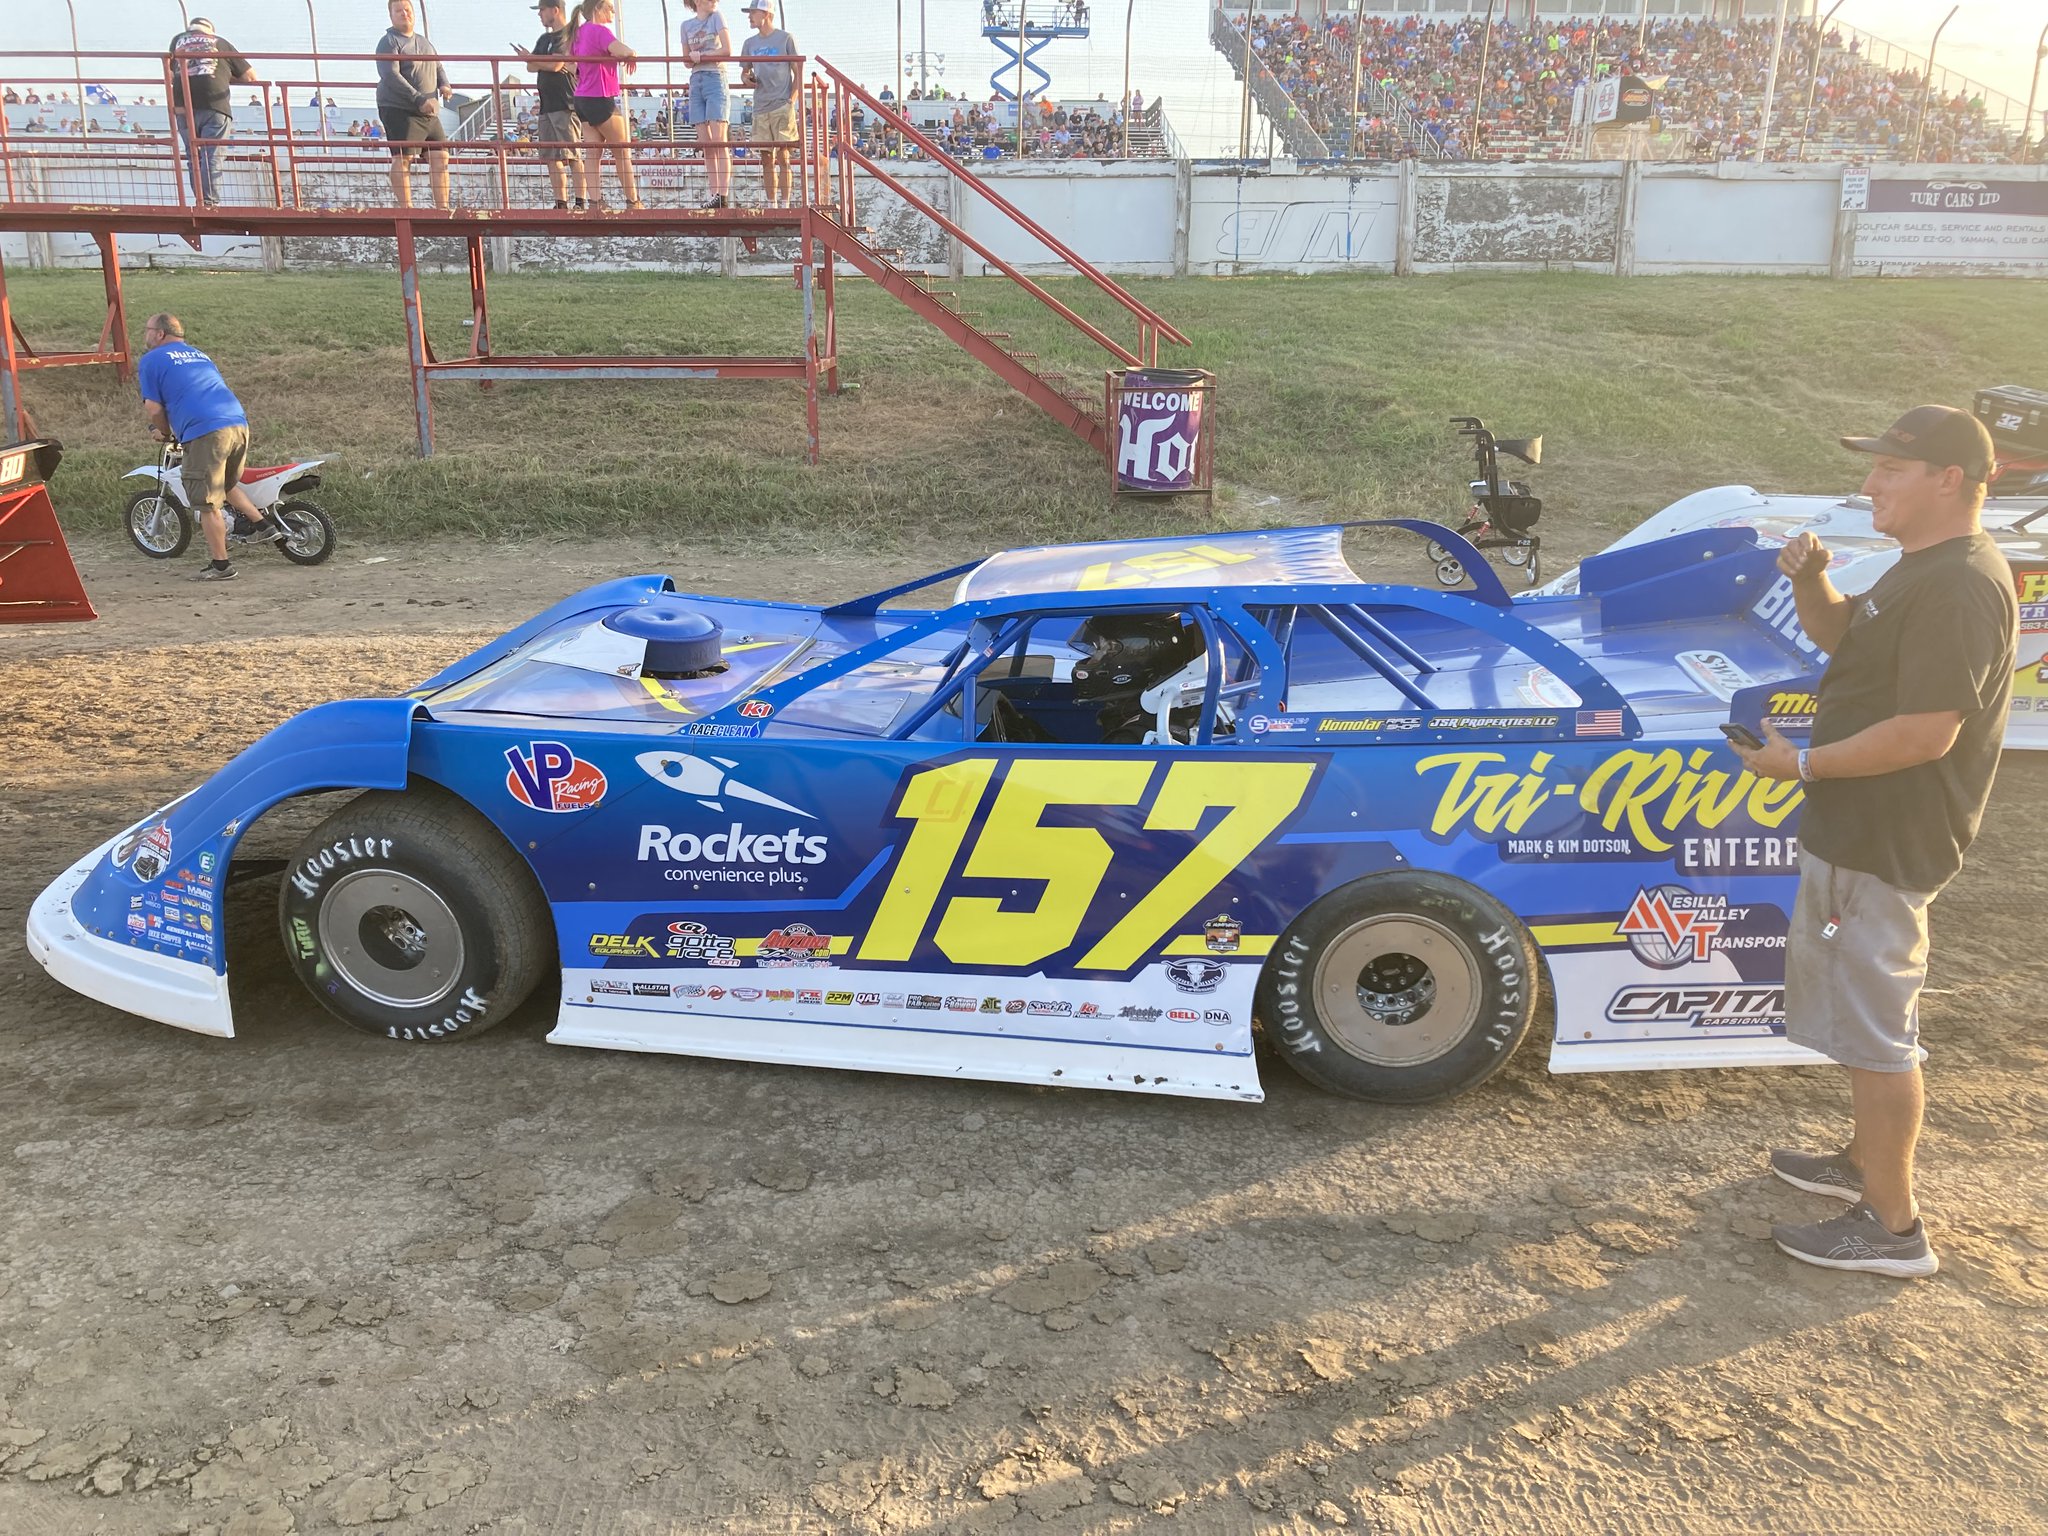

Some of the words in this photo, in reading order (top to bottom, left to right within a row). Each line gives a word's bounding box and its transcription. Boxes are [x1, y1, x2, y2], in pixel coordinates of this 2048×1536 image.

[651, 179, 673, 187] ONLY
[1910, 192, 1941, 207] TURF
[1945, 192, 1974, 208] CARS
[1979, 192, 2001, 206] LTD
[1856, 223, 1900, 231] GOLFCAR
[1904, 223, 1937, 232] SALES,
[2007, 225, 2046, 233] RENTALS
[1894, 235, 1920, 243] USED
[1960, 235, 1998, 244] YAMAHA,
[2002, 236, 2028, 244] CLUB
[1123, 391, 1199, 412] WELCOME
[1995, 413, 2023, 431] 32
[1, 453, 25, 483] 80
[741, 701, 772, 718] K1
[689, 723, 752, 737] RACECLEAN
[1318, 718, 1384, 732] Homolar
[1429, 718, 1457, 728] JSR
[1459, 718, 1533, 728] PROPERTIES
[1533, 717, 1557, 726] LLC
[504, 741, 575, 811] VP
[554, 776, 605, 802] Racing
[556, 802, 592, 810] FUELS
[637, 822, 828, 865] Rockets
[1508, 840, 1543, 854] MARK
[1545, 840, 1554, 854] &
[1557, 840, 1580, 853] KIM
[1582, 839, 1629, 853] DOTSON
[291, 833, 393, 899] Hoosier
[856, 758, 1315, 972] 157
[664, 867, 765, 883] convenience
[590, 934, 661, 958] DELK
[669, 934, 735, 948] gotta
[594, 947, 643, 955] EQUIPMENT
[676, 948, 735, 960] race
[708, 958, 741, 967] .com
[1276, 935, 1321, 1053] Hoosier
[1478, 925, 1520, 1051] Hoosier
[857, 993, 879, 1003] QA1
[387, 986, 489, 1041] Hoosier
[1169, 1011, 1197, 1020] BELL
[1205, 1012, 1229, 1020] DNA
